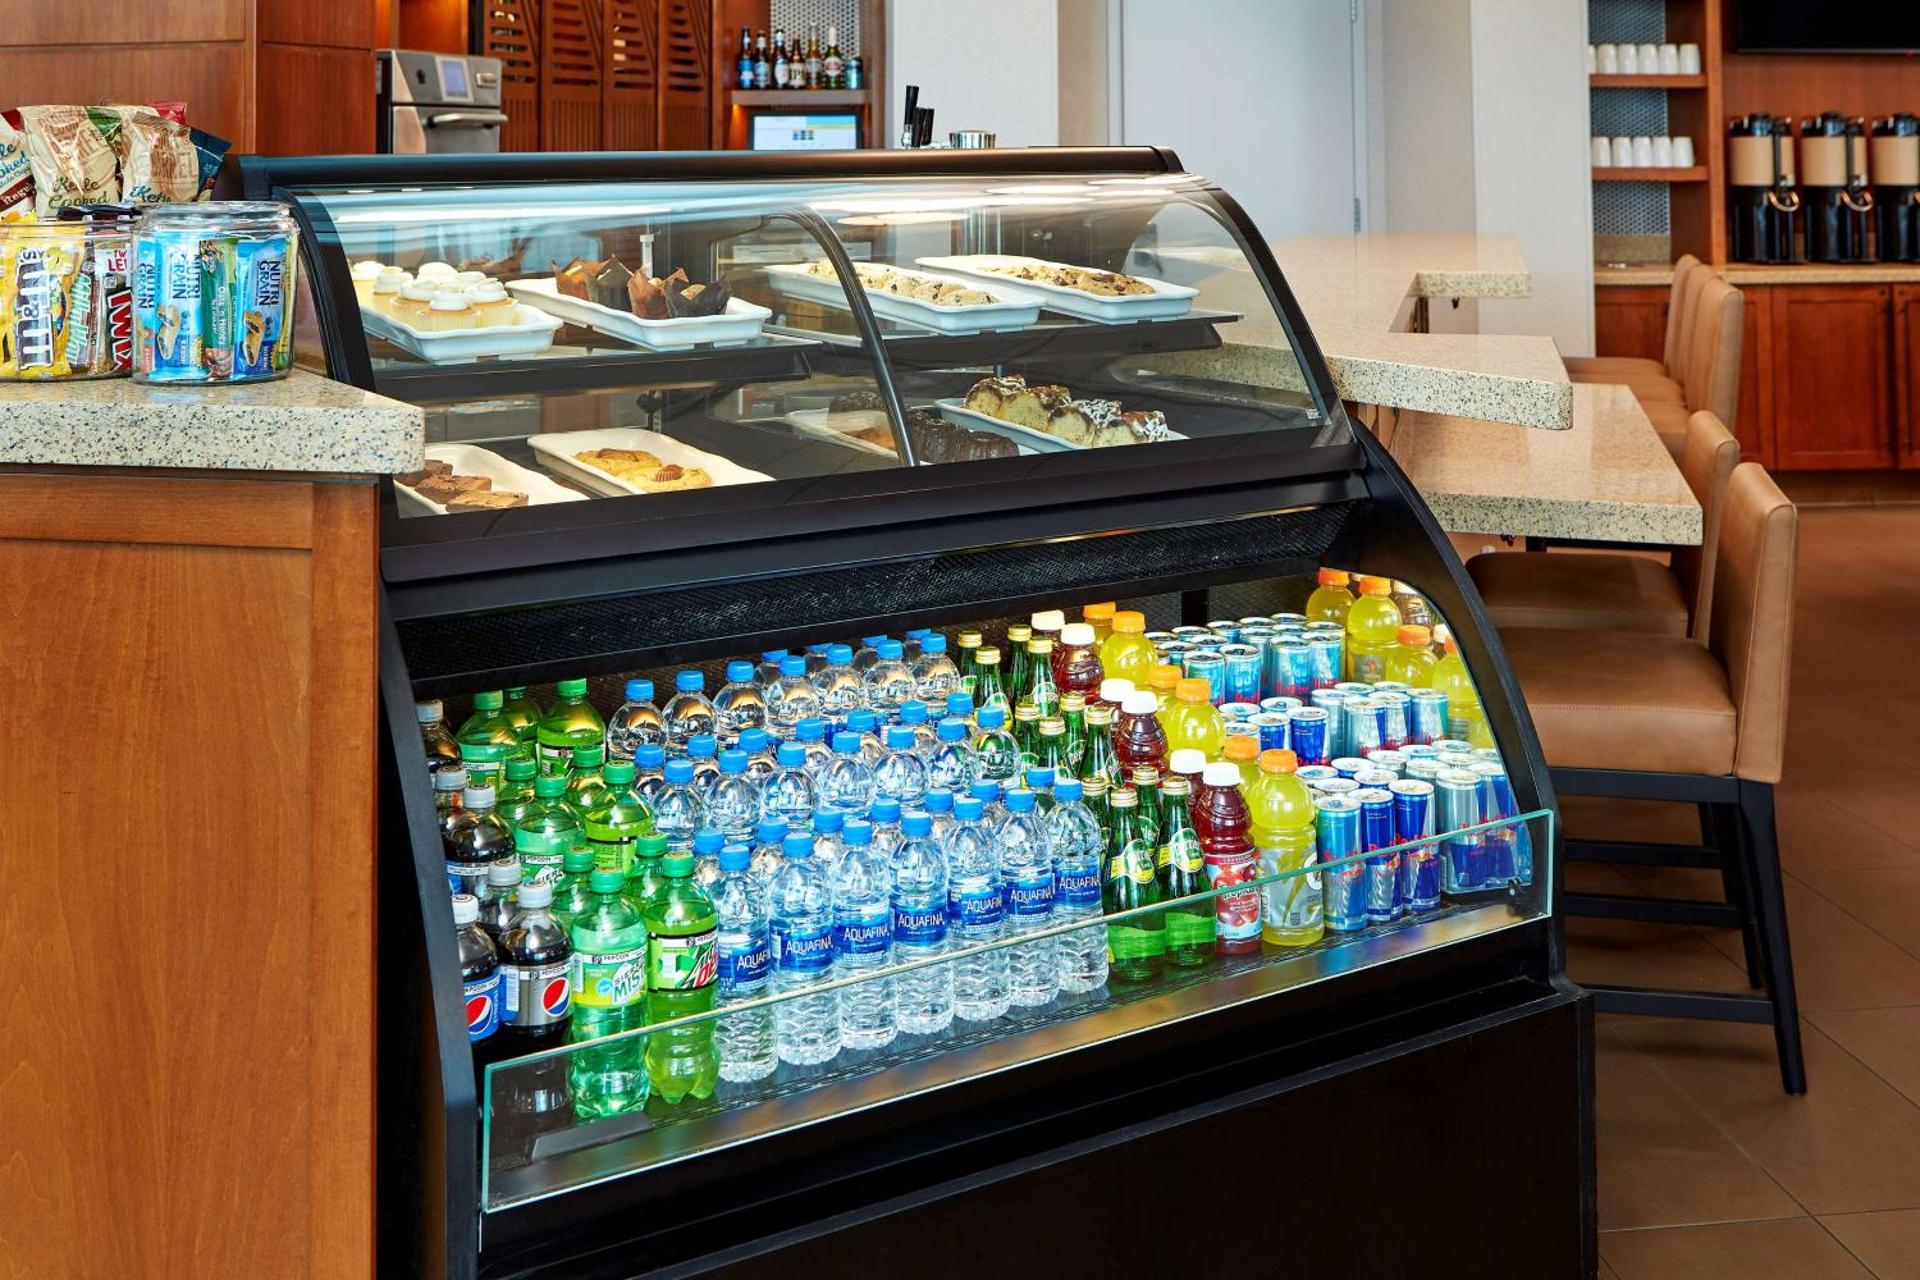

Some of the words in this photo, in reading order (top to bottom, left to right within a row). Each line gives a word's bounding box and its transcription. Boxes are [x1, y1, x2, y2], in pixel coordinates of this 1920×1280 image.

[259, 260, 271, 306] GRAIN
[269, 260, 281, 305] NUTRI
[898, 912, 944, 929] AQUAFINA
[785, 934, 832, 956] AQUAFINA
[843, 926, 890, 944] AQUAFINA
[736, 949, 771, 971] AQUAF
